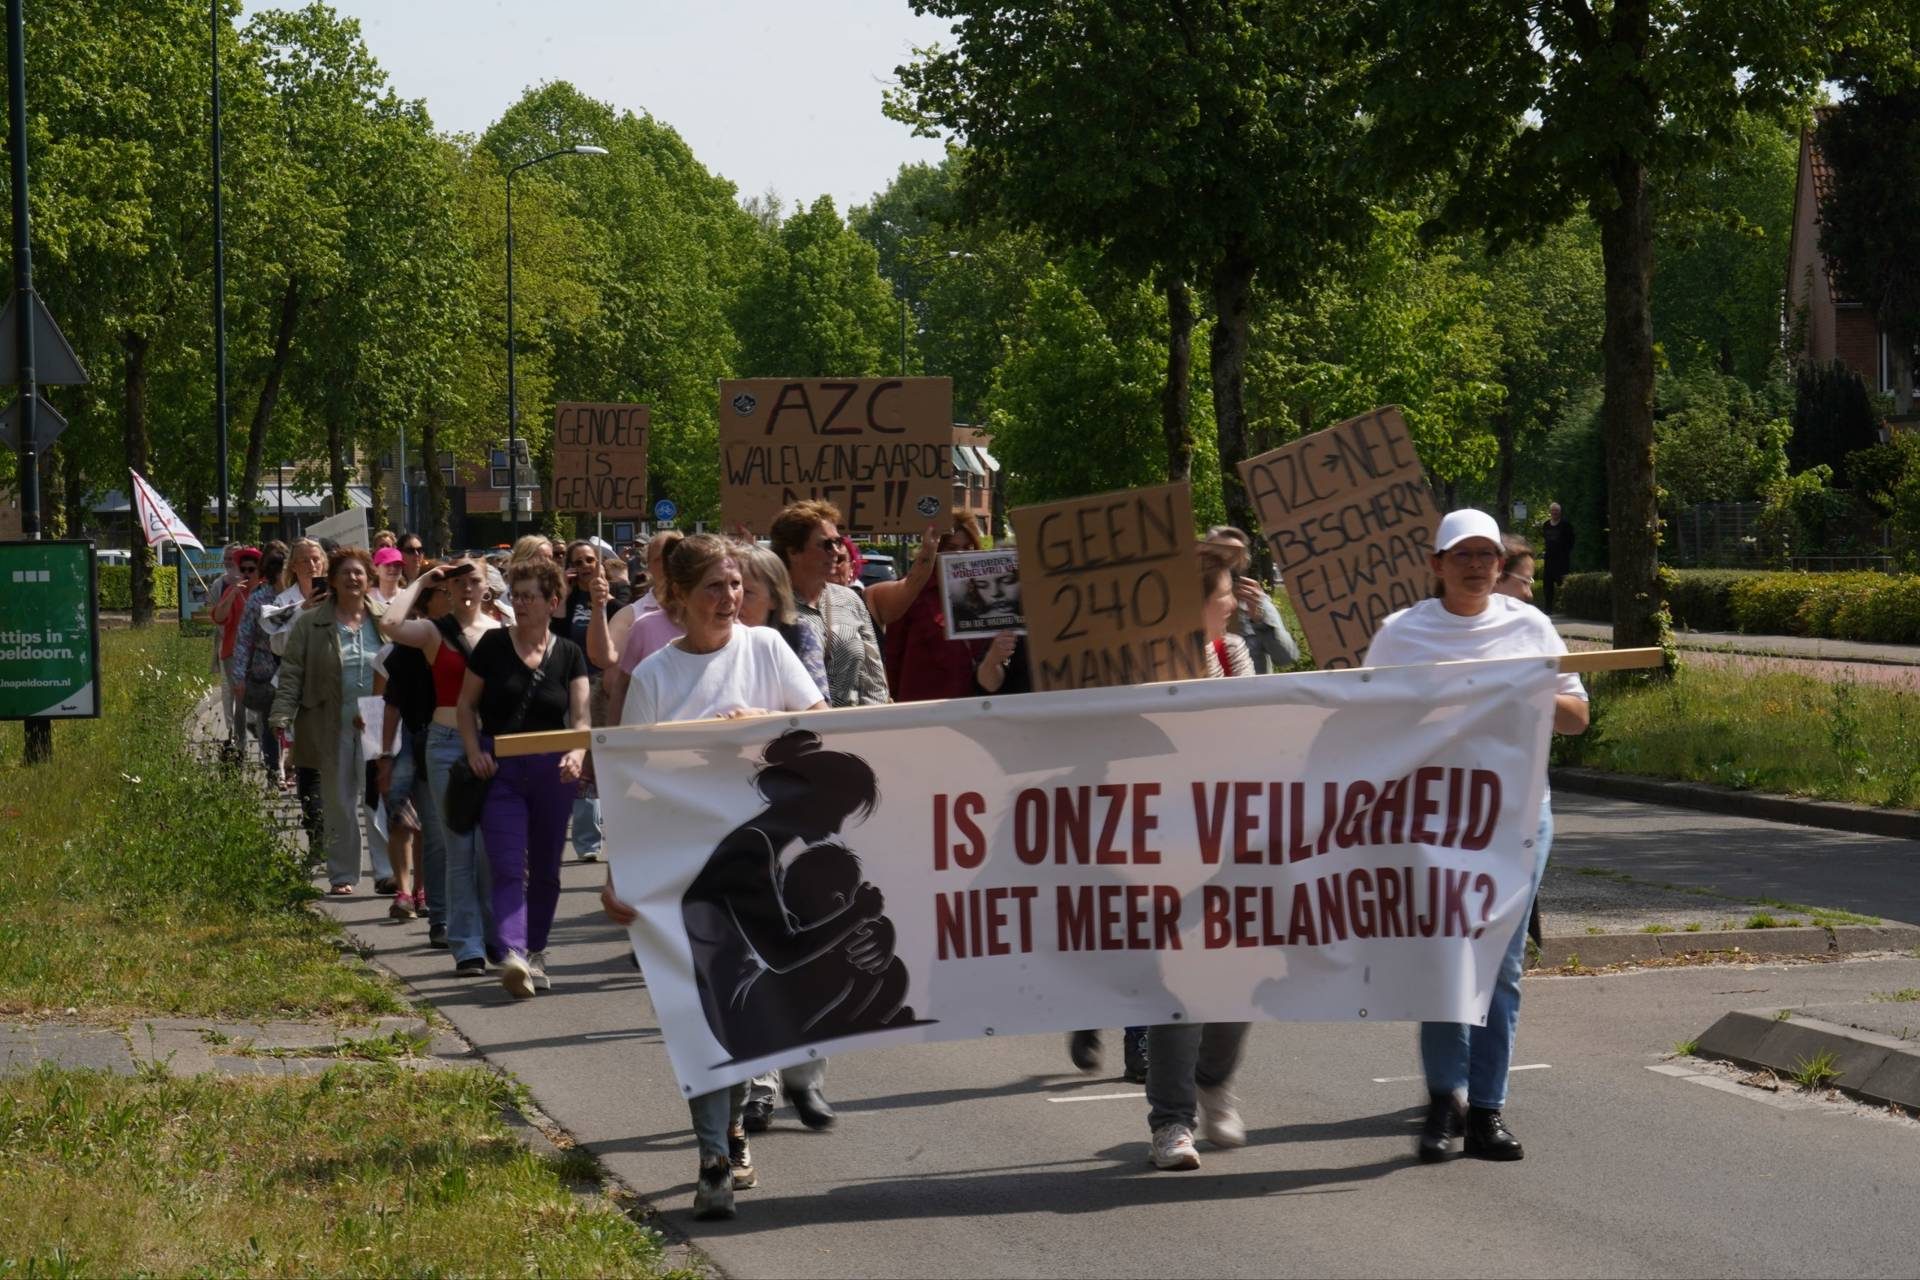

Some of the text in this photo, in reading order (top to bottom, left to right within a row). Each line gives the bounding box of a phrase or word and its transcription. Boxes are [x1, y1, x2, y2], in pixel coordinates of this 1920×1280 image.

[558, 408, 645, 446] GENOEG
[764, 382, 907, 435] AZC
[555, 477, 644, 510] GENOEG
[727, 444, 950, 486] WALEWEINGAARDE
[1250, 412, 1413, 522] AZC NEE
[1038, 493, 1178, 570] GEEN
[1268, 480, 1427, 573] BESCHERM
[1297, 526, 1435, 613] ELKAAR
[46, 628, 63, 644] in
[1052, 569, 1170, 642] 240
[0, 678, 71, 689] inapeldoorn.nl
[1040, 629, 1207, 690] MANNEN
[934, 766, 1502, 871] IS ONZE VEILIGHEID
[935, 867, 1497, 960] NIET MEER BELANGRIJK?
